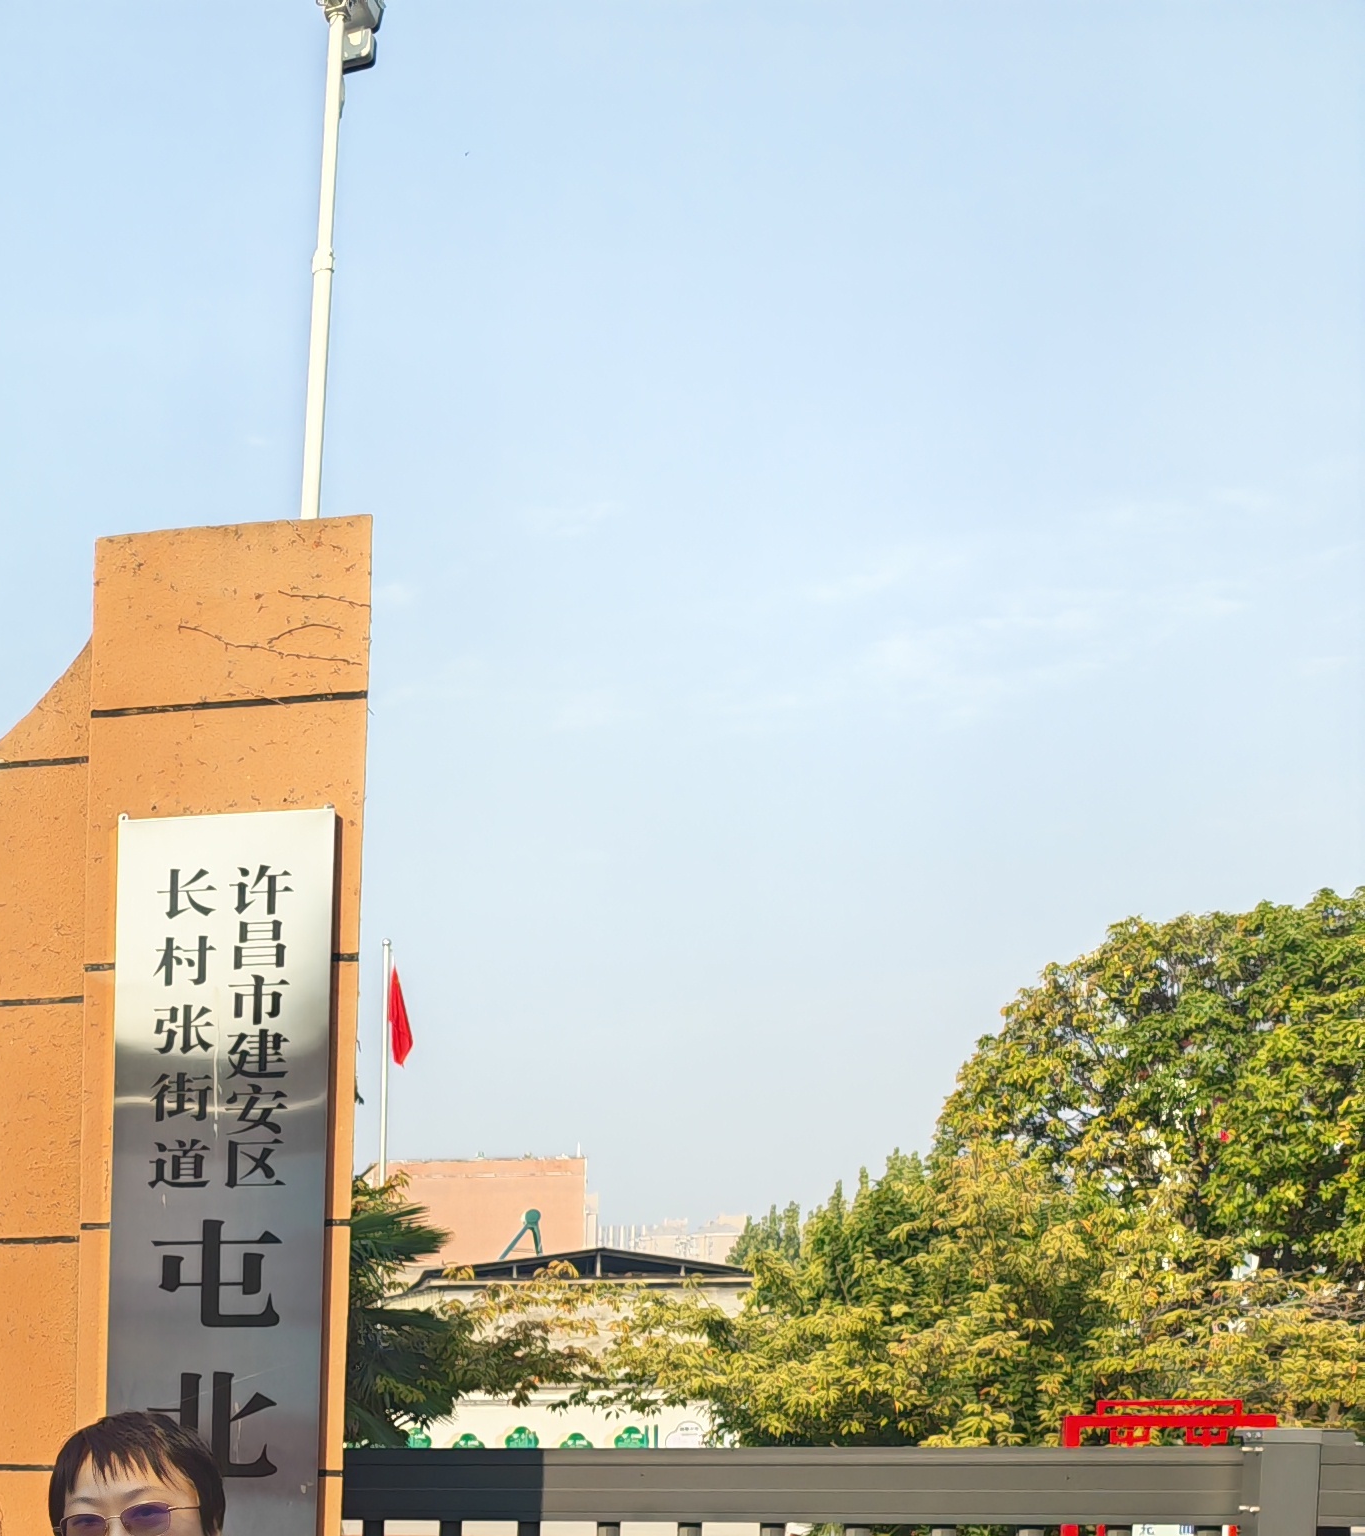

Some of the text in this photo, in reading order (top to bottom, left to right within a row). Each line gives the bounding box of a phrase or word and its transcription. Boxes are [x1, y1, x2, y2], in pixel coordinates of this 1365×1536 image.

[147, 867, 218, 1189] 长村张街道
[224, 864, 295, 1189] 许昌市建安区
